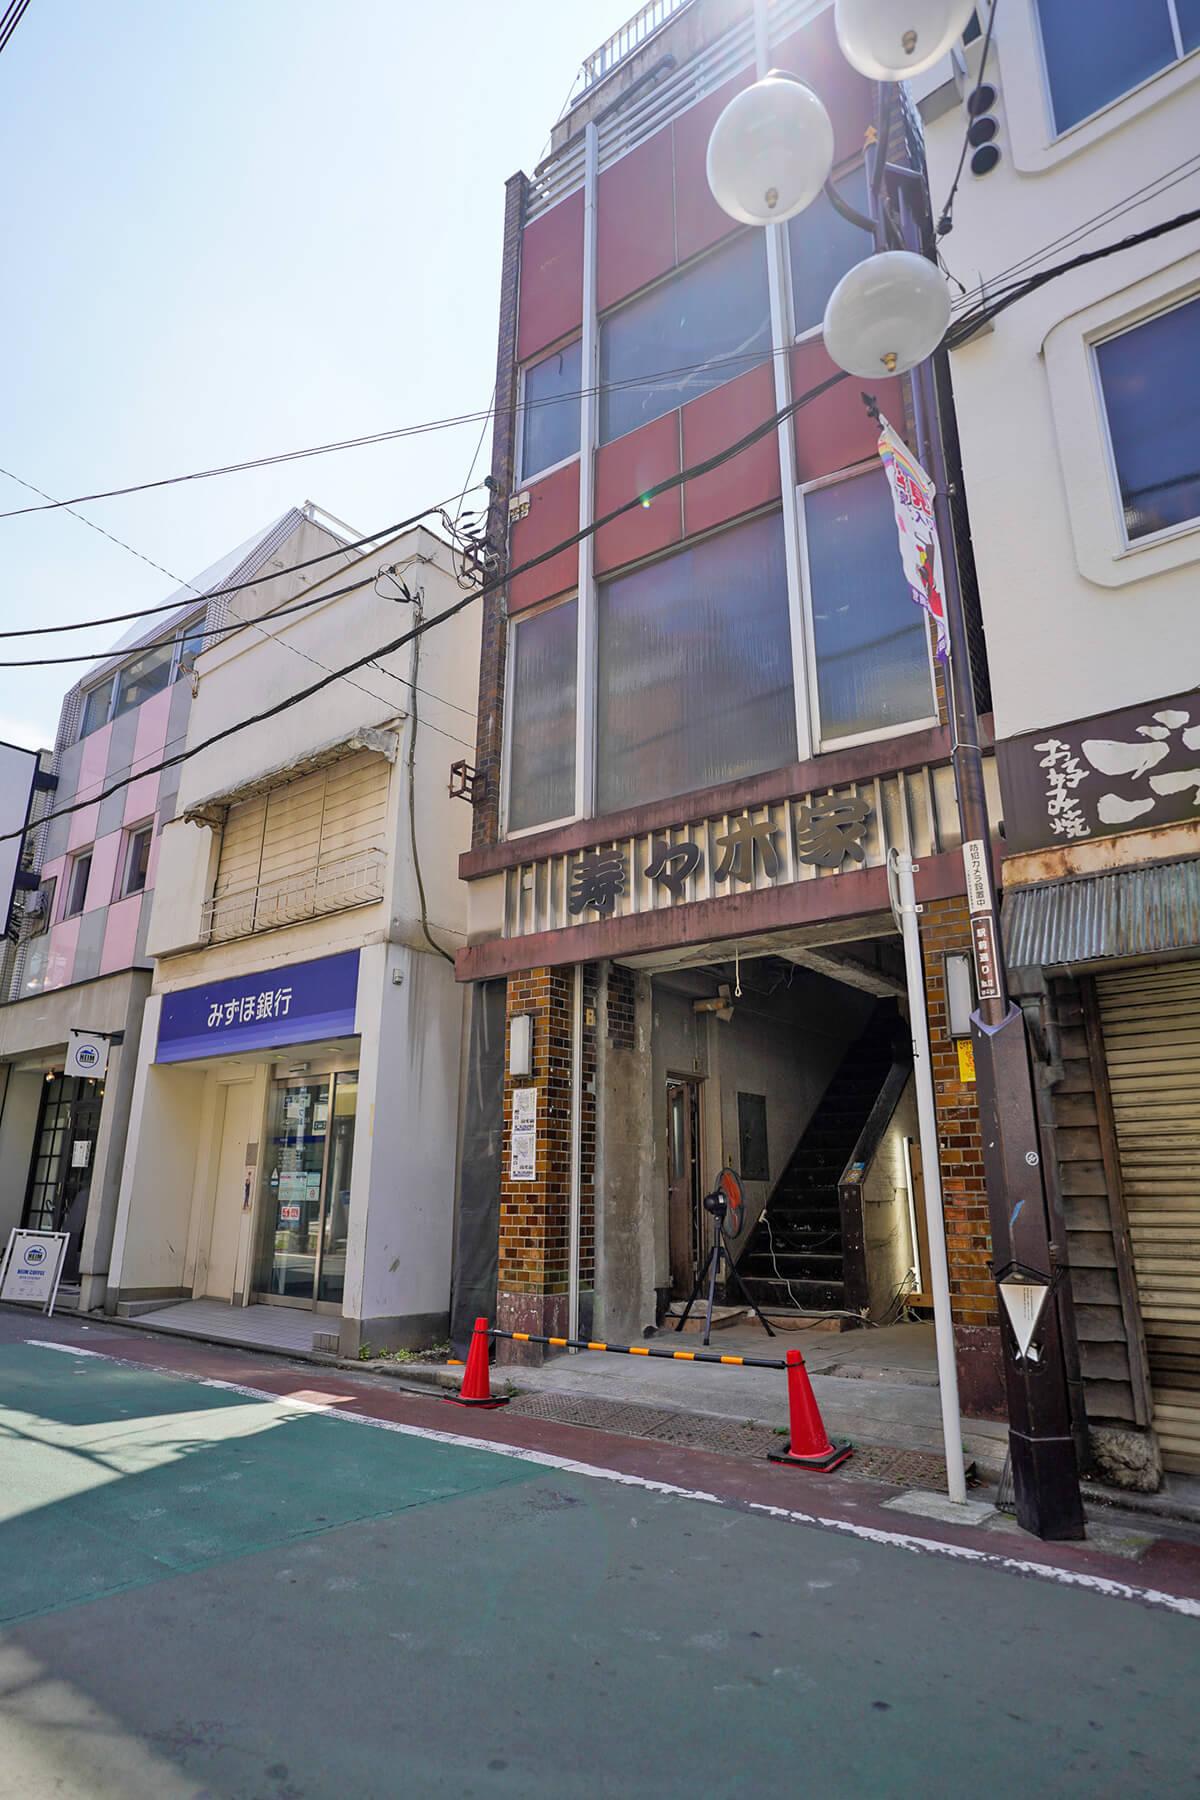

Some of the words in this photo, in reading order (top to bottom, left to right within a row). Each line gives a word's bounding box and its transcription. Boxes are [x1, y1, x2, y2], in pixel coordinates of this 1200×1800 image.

[1034, 739, 1091, 838] お好み焼
[207, 987, 293, 1028] みずほ銀行
